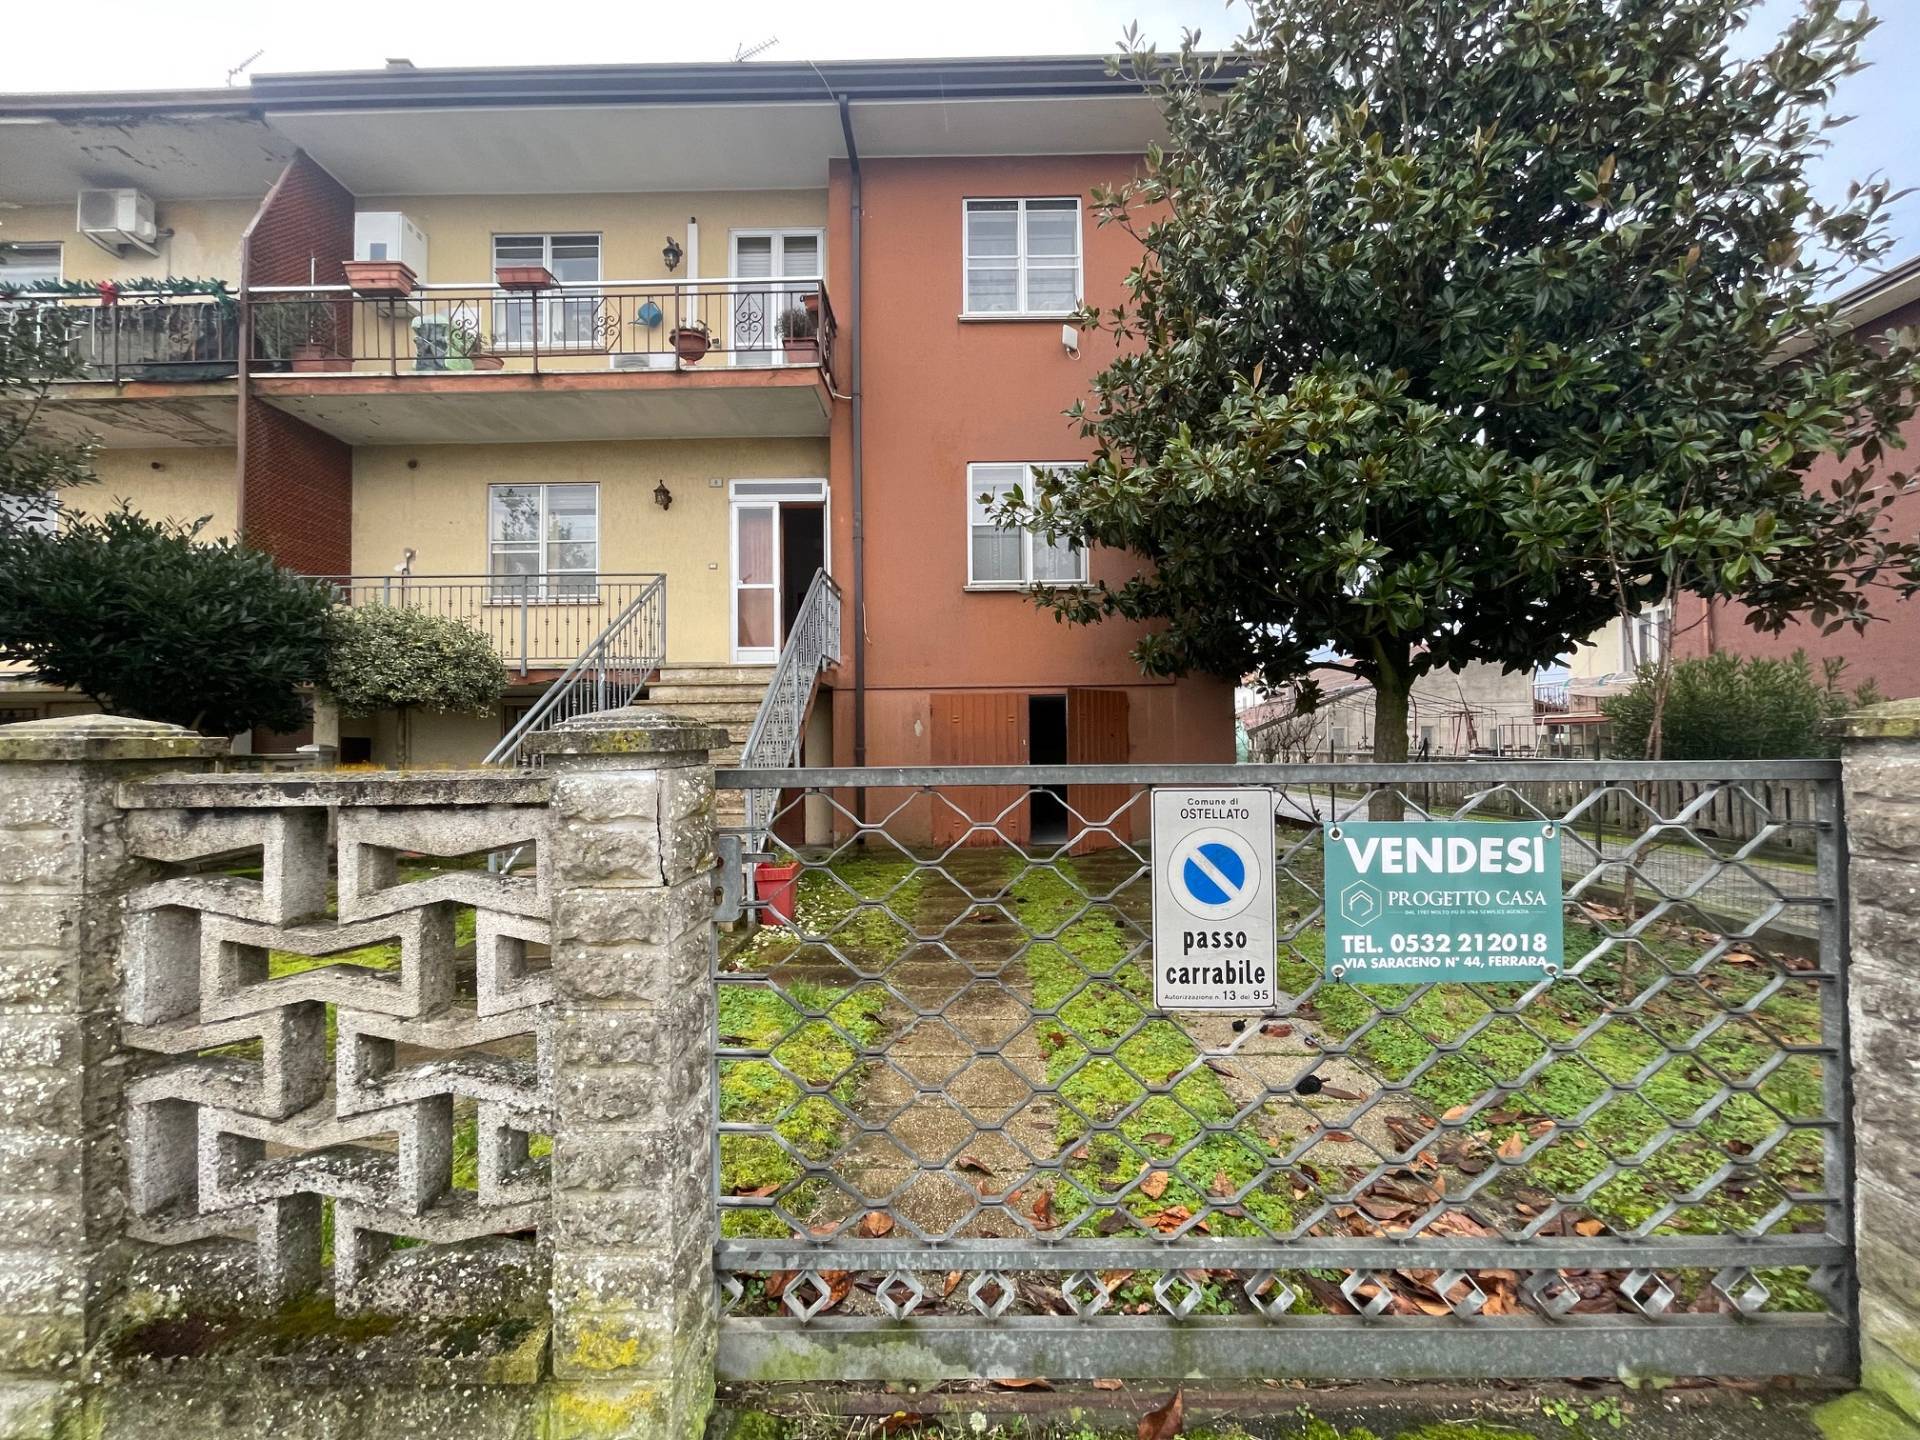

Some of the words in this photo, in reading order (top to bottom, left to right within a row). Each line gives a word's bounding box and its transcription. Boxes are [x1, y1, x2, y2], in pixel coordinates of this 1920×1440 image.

[1187, 798, 1226, 806] Comune
[1230, 798, 1239, 806] di
[1180, 808, 1249, 820] OSTELLATO
[1343, 837, 1545, 874] VENDESI
[1388, 890, 1490, 907] PROGETTO
[1495, 890, 1547, 906] CASA
[1183, 931, 1247, 956] passo
[1341, 934, 1383, 953] TEL.
[1390, 933, 1450, 953] 0532
[1457, 932, 1548, 953] 212018
[1343, 957, 1366, 968] VIA
[1371, 956, 1441, 969] SARACENO
[1463, 956, 1485, 968] 44,
[1488, 955, 1547, 967] FERRARA
[1166, 960, 1266, 985] carrabile
[1223, 990, 1237, 1001] 13
[1253, 990, 1269, 1000] 95
